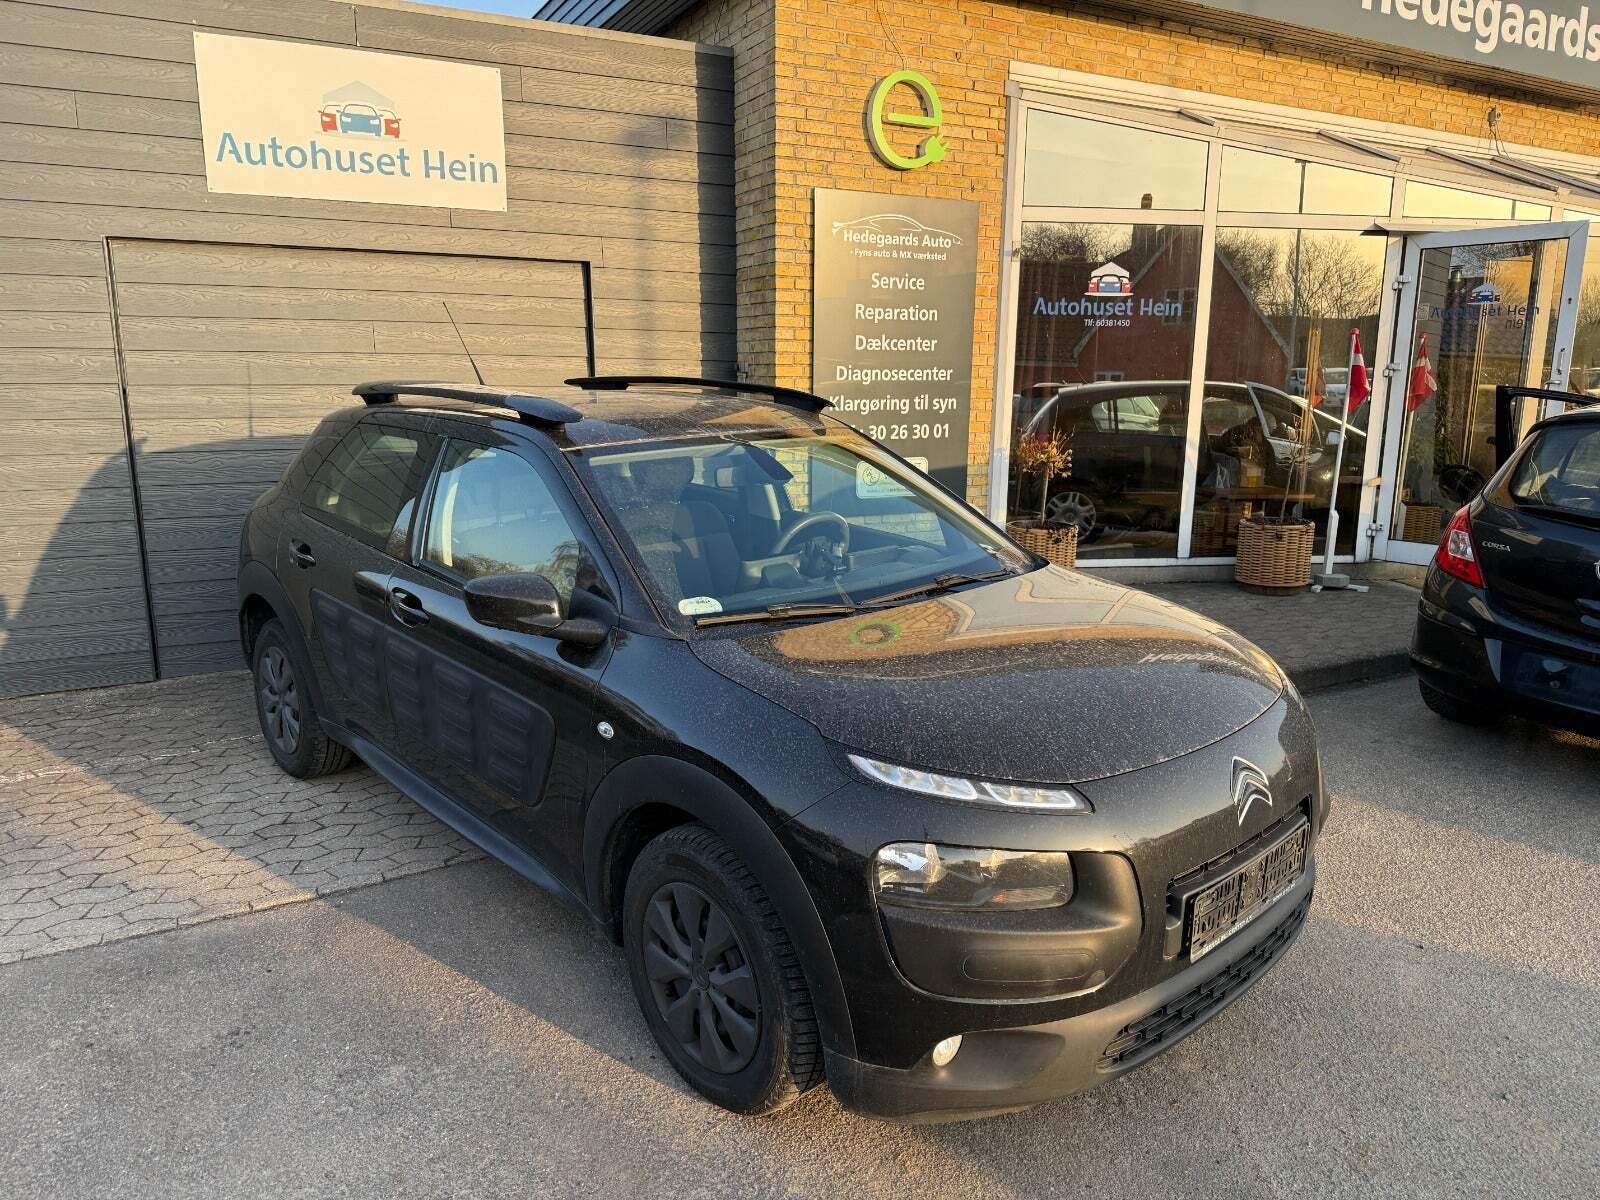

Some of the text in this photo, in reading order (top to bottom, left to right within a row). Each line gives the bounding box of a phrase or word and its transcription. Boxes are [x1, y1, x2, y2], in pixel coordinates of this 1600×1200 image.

[216, 131, 499, 184] Autohuset Hein
[843, 229, 952, 249] Hedegaards Auto
[854, 248, 872, 258] Fyns
[873, 250, 891, 258] auto
[900, 250, 912, 259] MX
[871, 272, 926, 291] Service
[855, 303, 939, 324] Reparation
[1033, 297, 1182, 317] Autohuset Hein
[1096, 318, 1131, 328] 60381450
[855, 334, 938, 352] Dækcenter
[836, 364, 954, 385] Diagnosecenter
[829, 394, 957, 415] Klargøring til syn
[868, 424, 887, 441] 30
[890, 424, 908, 440] 26
[912, 424, 930, 440] 30
[933, 423, 950, 439] 01
[1481, 540, 1511, 552] CORSA
